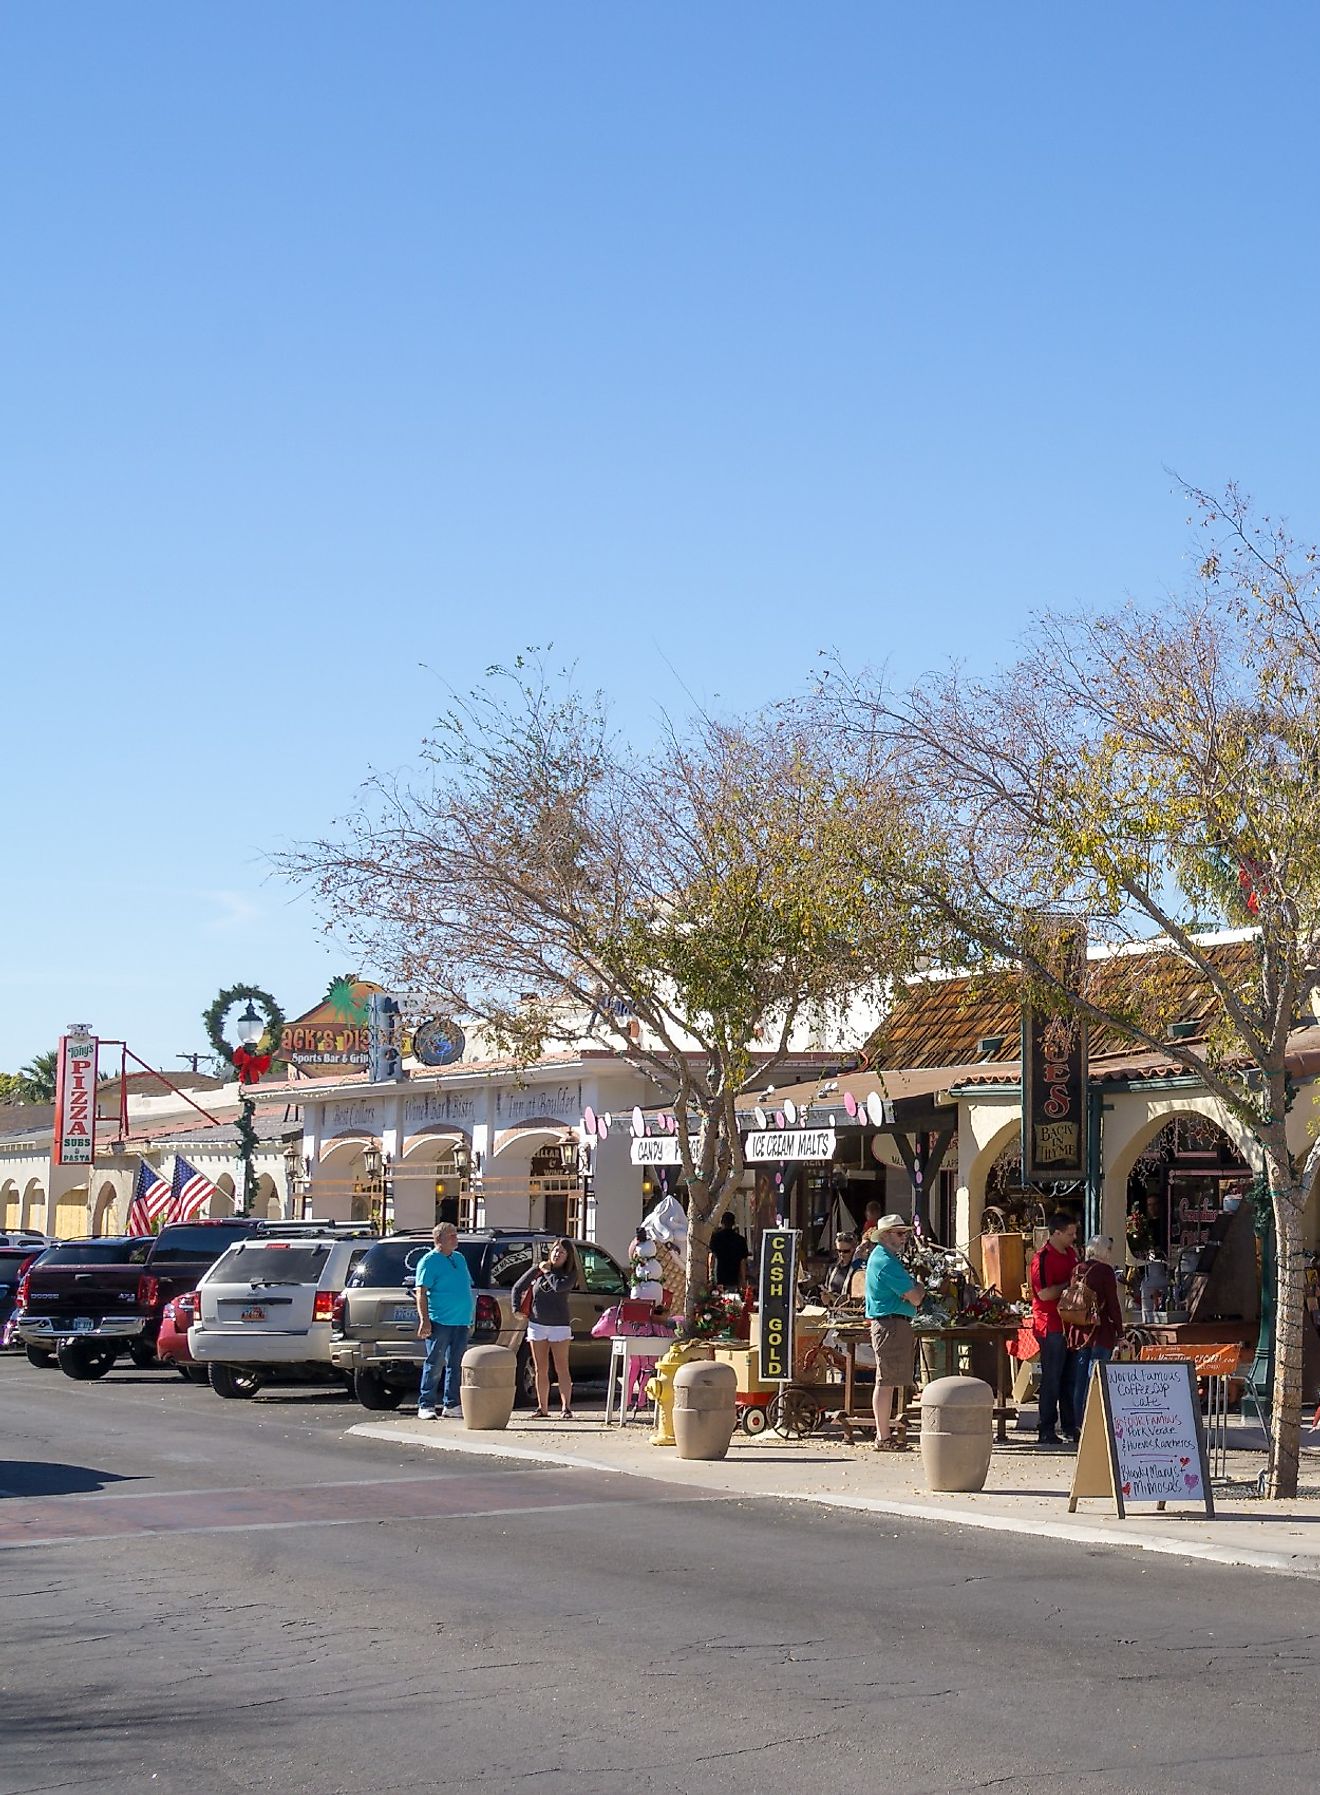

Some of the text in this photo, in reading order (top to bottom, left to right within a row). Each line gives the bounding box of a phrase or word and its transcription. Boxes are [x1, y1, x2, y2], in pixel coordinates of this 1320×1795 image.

[67, 1043, 94, 1059] Tony's
[291, 1051, 323, 1065] Sports
[324, 1052, 340, 1063] Bar
[342, 1053, 348, 1063] &
[66, 1060, 92, 1136] PIZZA
[537, 1086, 576, 1116] Boulder
[1041, 1125, 1073, 1143] BACK
[1052, 1137, 1064, 1147] IN
[64, 1138, 91, 1147] SUBS
[637, 1140, 664, 1161] CANDY
[674, 1139, 704, 1161] FGE
[752, 1132, 829, 1158] ICE CREAM MALTS
[63, 1154, 91, 1162] PASTA
[1040, 1144, 1075, 1161] THYME
[768, 1237, 785, 1375] CASH GOLD
[1109, 1369, 1181, 1383] World Famous
[1117, 1382, 1170, 1397] Coffee Cup
[1148, 1426, 1177, 1437] Verde
[1127, 1439, 1154, 1452] Huevos
[1120, 1464, 1150, 1482] Bloody
